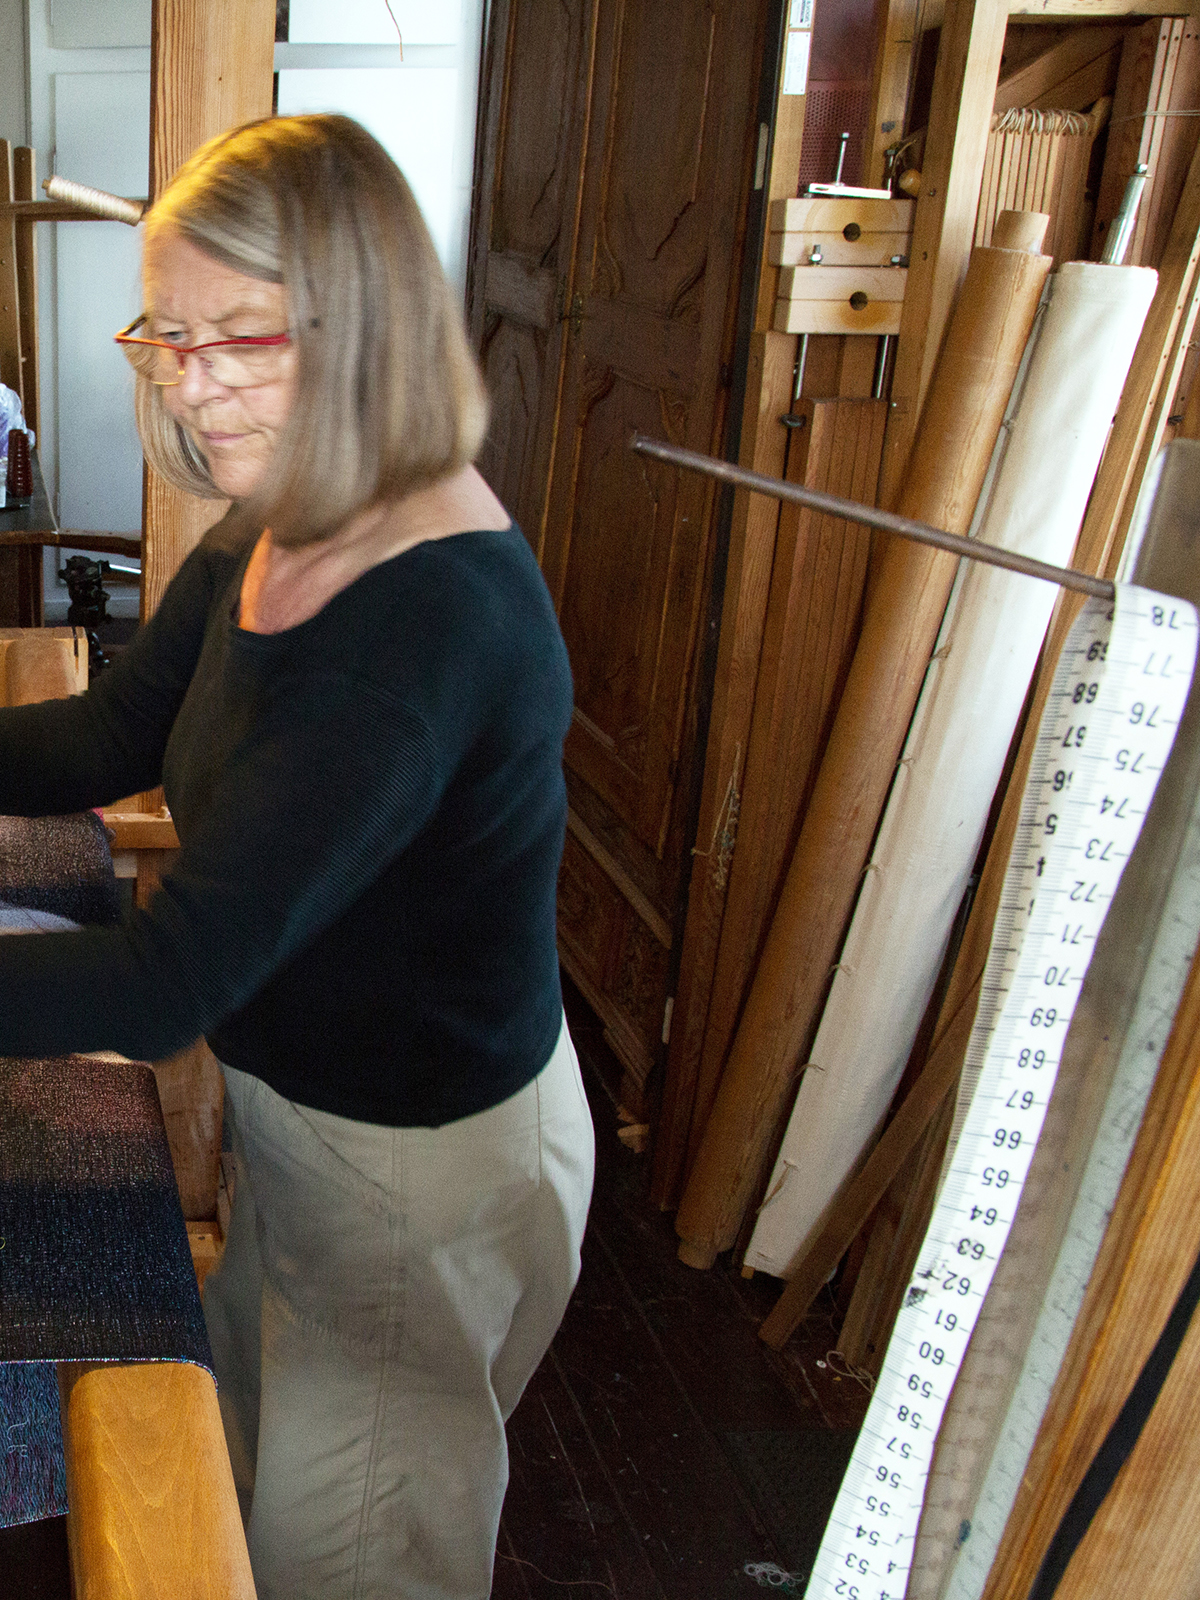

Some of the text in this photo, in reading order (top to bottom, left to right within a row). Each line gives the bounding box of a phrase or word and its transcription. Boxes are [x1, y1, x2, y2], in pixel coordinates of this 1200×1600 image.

[1152, 605, 1179, 630] 78
[1143, 652, 1171, 678] 77
[1072, 682, 1099, 704] 68
[1129, 702, 1160, 728] 76
[1115, 749, 1144, 773] 75
[1100, 795, 1129, 818] 74
[1085, 838, 1113, 861] 73
[1070, 880, 1098, 902] 72
[1061, 924, 1083, 944] 71
[1044, 966, 1070, 987] 70
[1030, 1007, 1057, 1028] 69
[1017, 1048, 1046, 1070] 68
[1005, 1090, 1034, 1110] 67
[992, 1128, 1022, 1150] 66
[981, 1167, 1010, 1189] 65
[969, 1205, 998, 1226] 64
[957, 1238, 985, 1260] 63
[934, 1308, 958, 1331] 61
[918, 1341, 945, 1366] 60
[907, 1374, 933, 1399] 59
[897, 1404, 922, 1430] 58
[886, 1436, 912, 1460] 57
[875, 1465, 902, 1489] 56
[865, 1496, 890, 1517] 55
[856, 1525, 880, 1546] 54
[845, 1552, 869, 1575] 53
